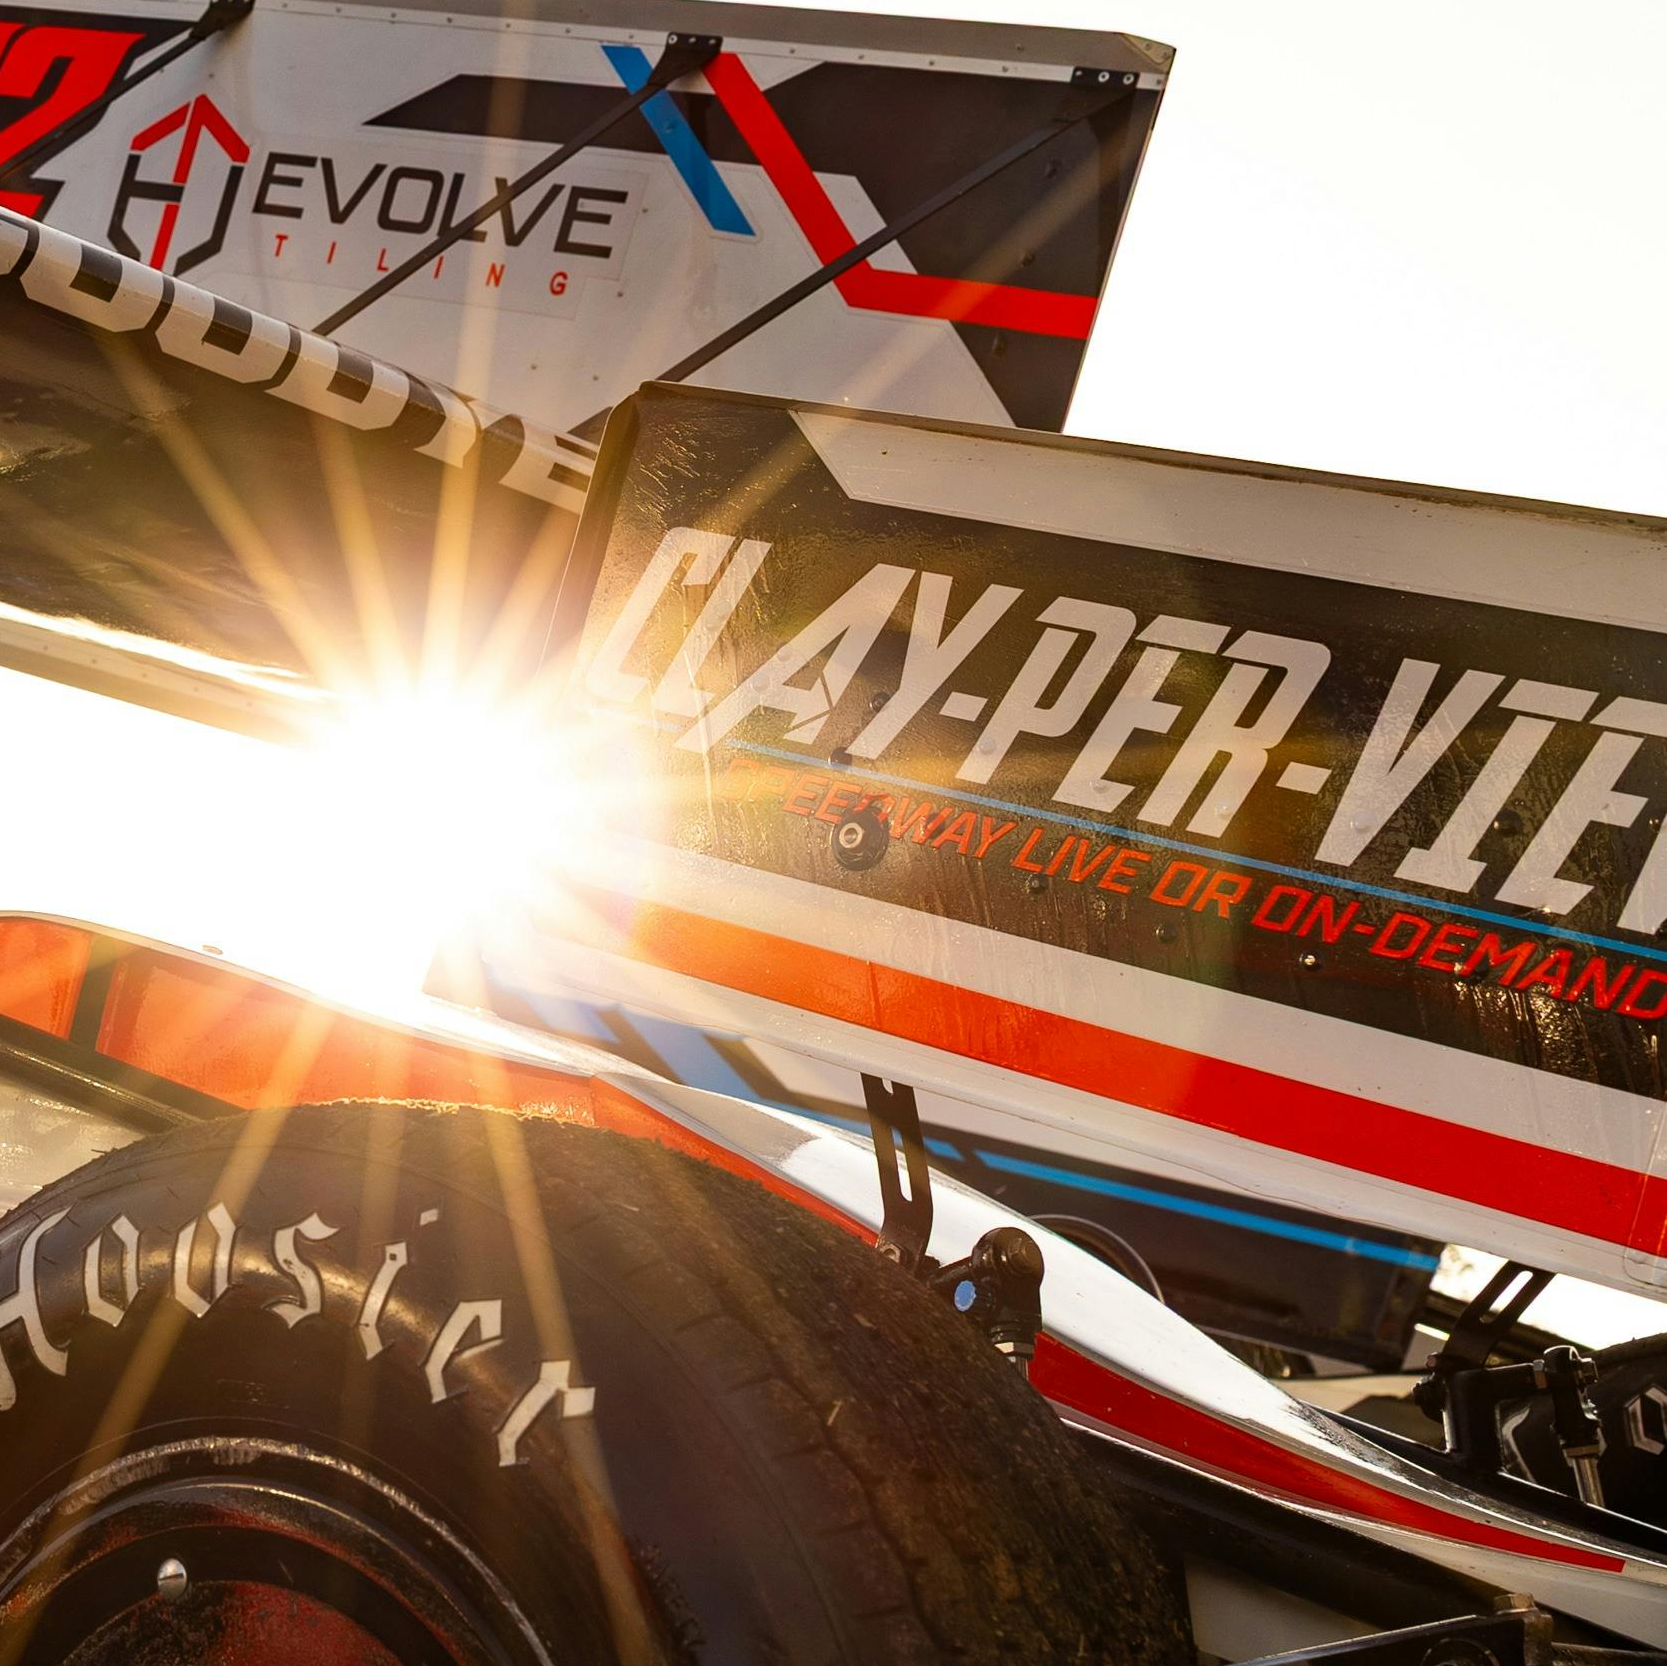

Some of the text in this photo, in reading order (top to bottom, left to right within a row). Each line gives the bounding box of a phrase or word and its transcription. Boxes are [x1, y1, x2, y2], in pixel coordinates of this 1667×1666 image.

[252, 151, 628, 259] EVOLVE
[274, 234, 568, 297] TILING
[1011, 828, 1152, 895] LIVE
[1149, 860, 1252, 919] OR
[1251, 884, 1667, 1020] ON-DEMAND
